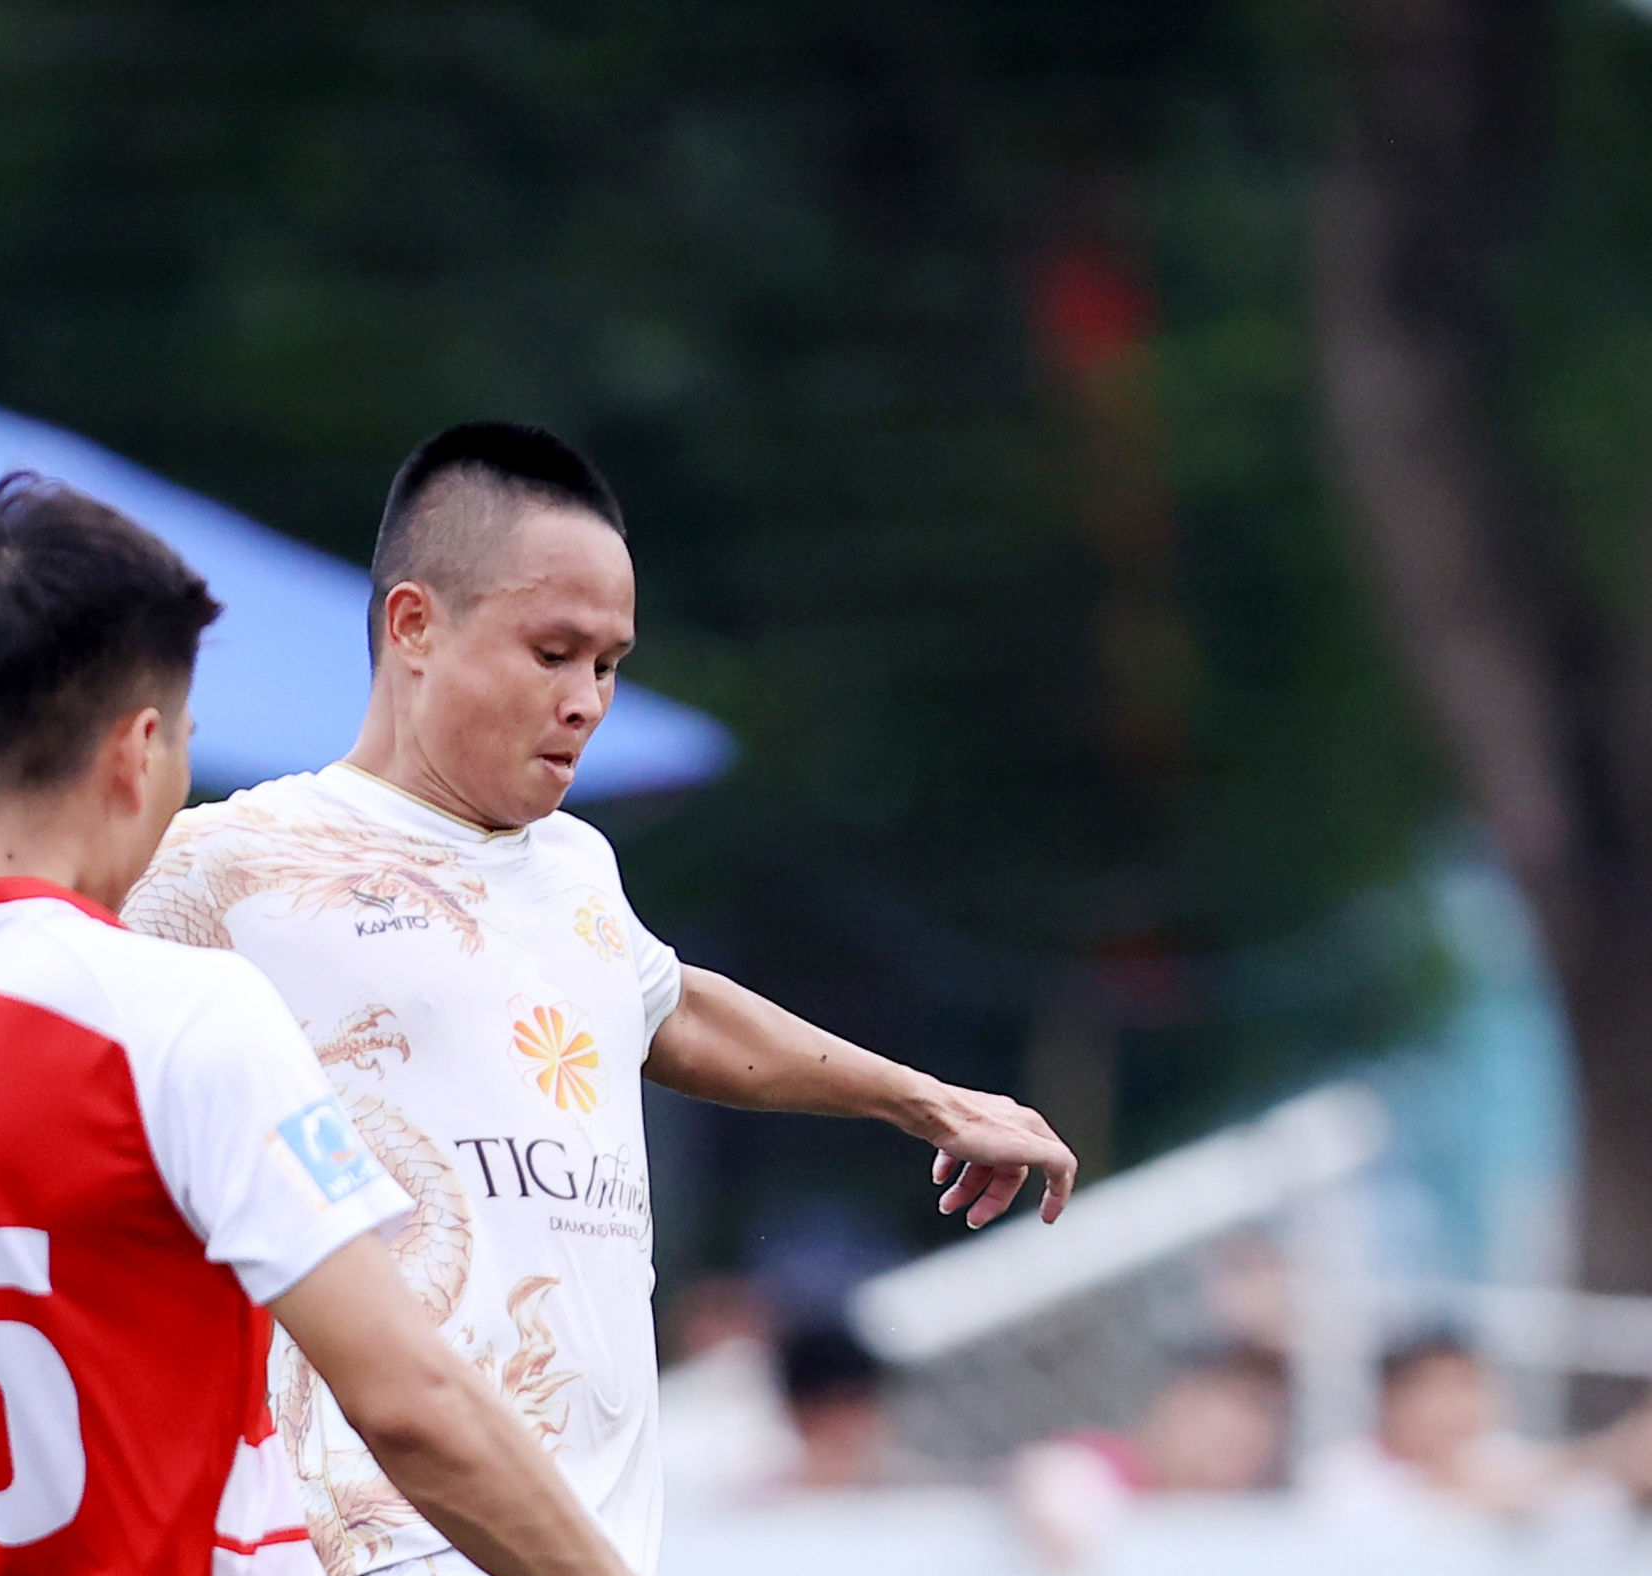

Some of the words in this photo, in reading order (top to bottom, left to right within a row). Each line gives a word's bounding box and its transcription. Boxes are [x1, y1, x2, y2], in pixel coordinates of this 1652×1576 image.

[354, 915, 429, 937] KAMITO
[453, 1137, 579, 1200] TIG
[549, 1216, 608, 1238] DIAMOND
